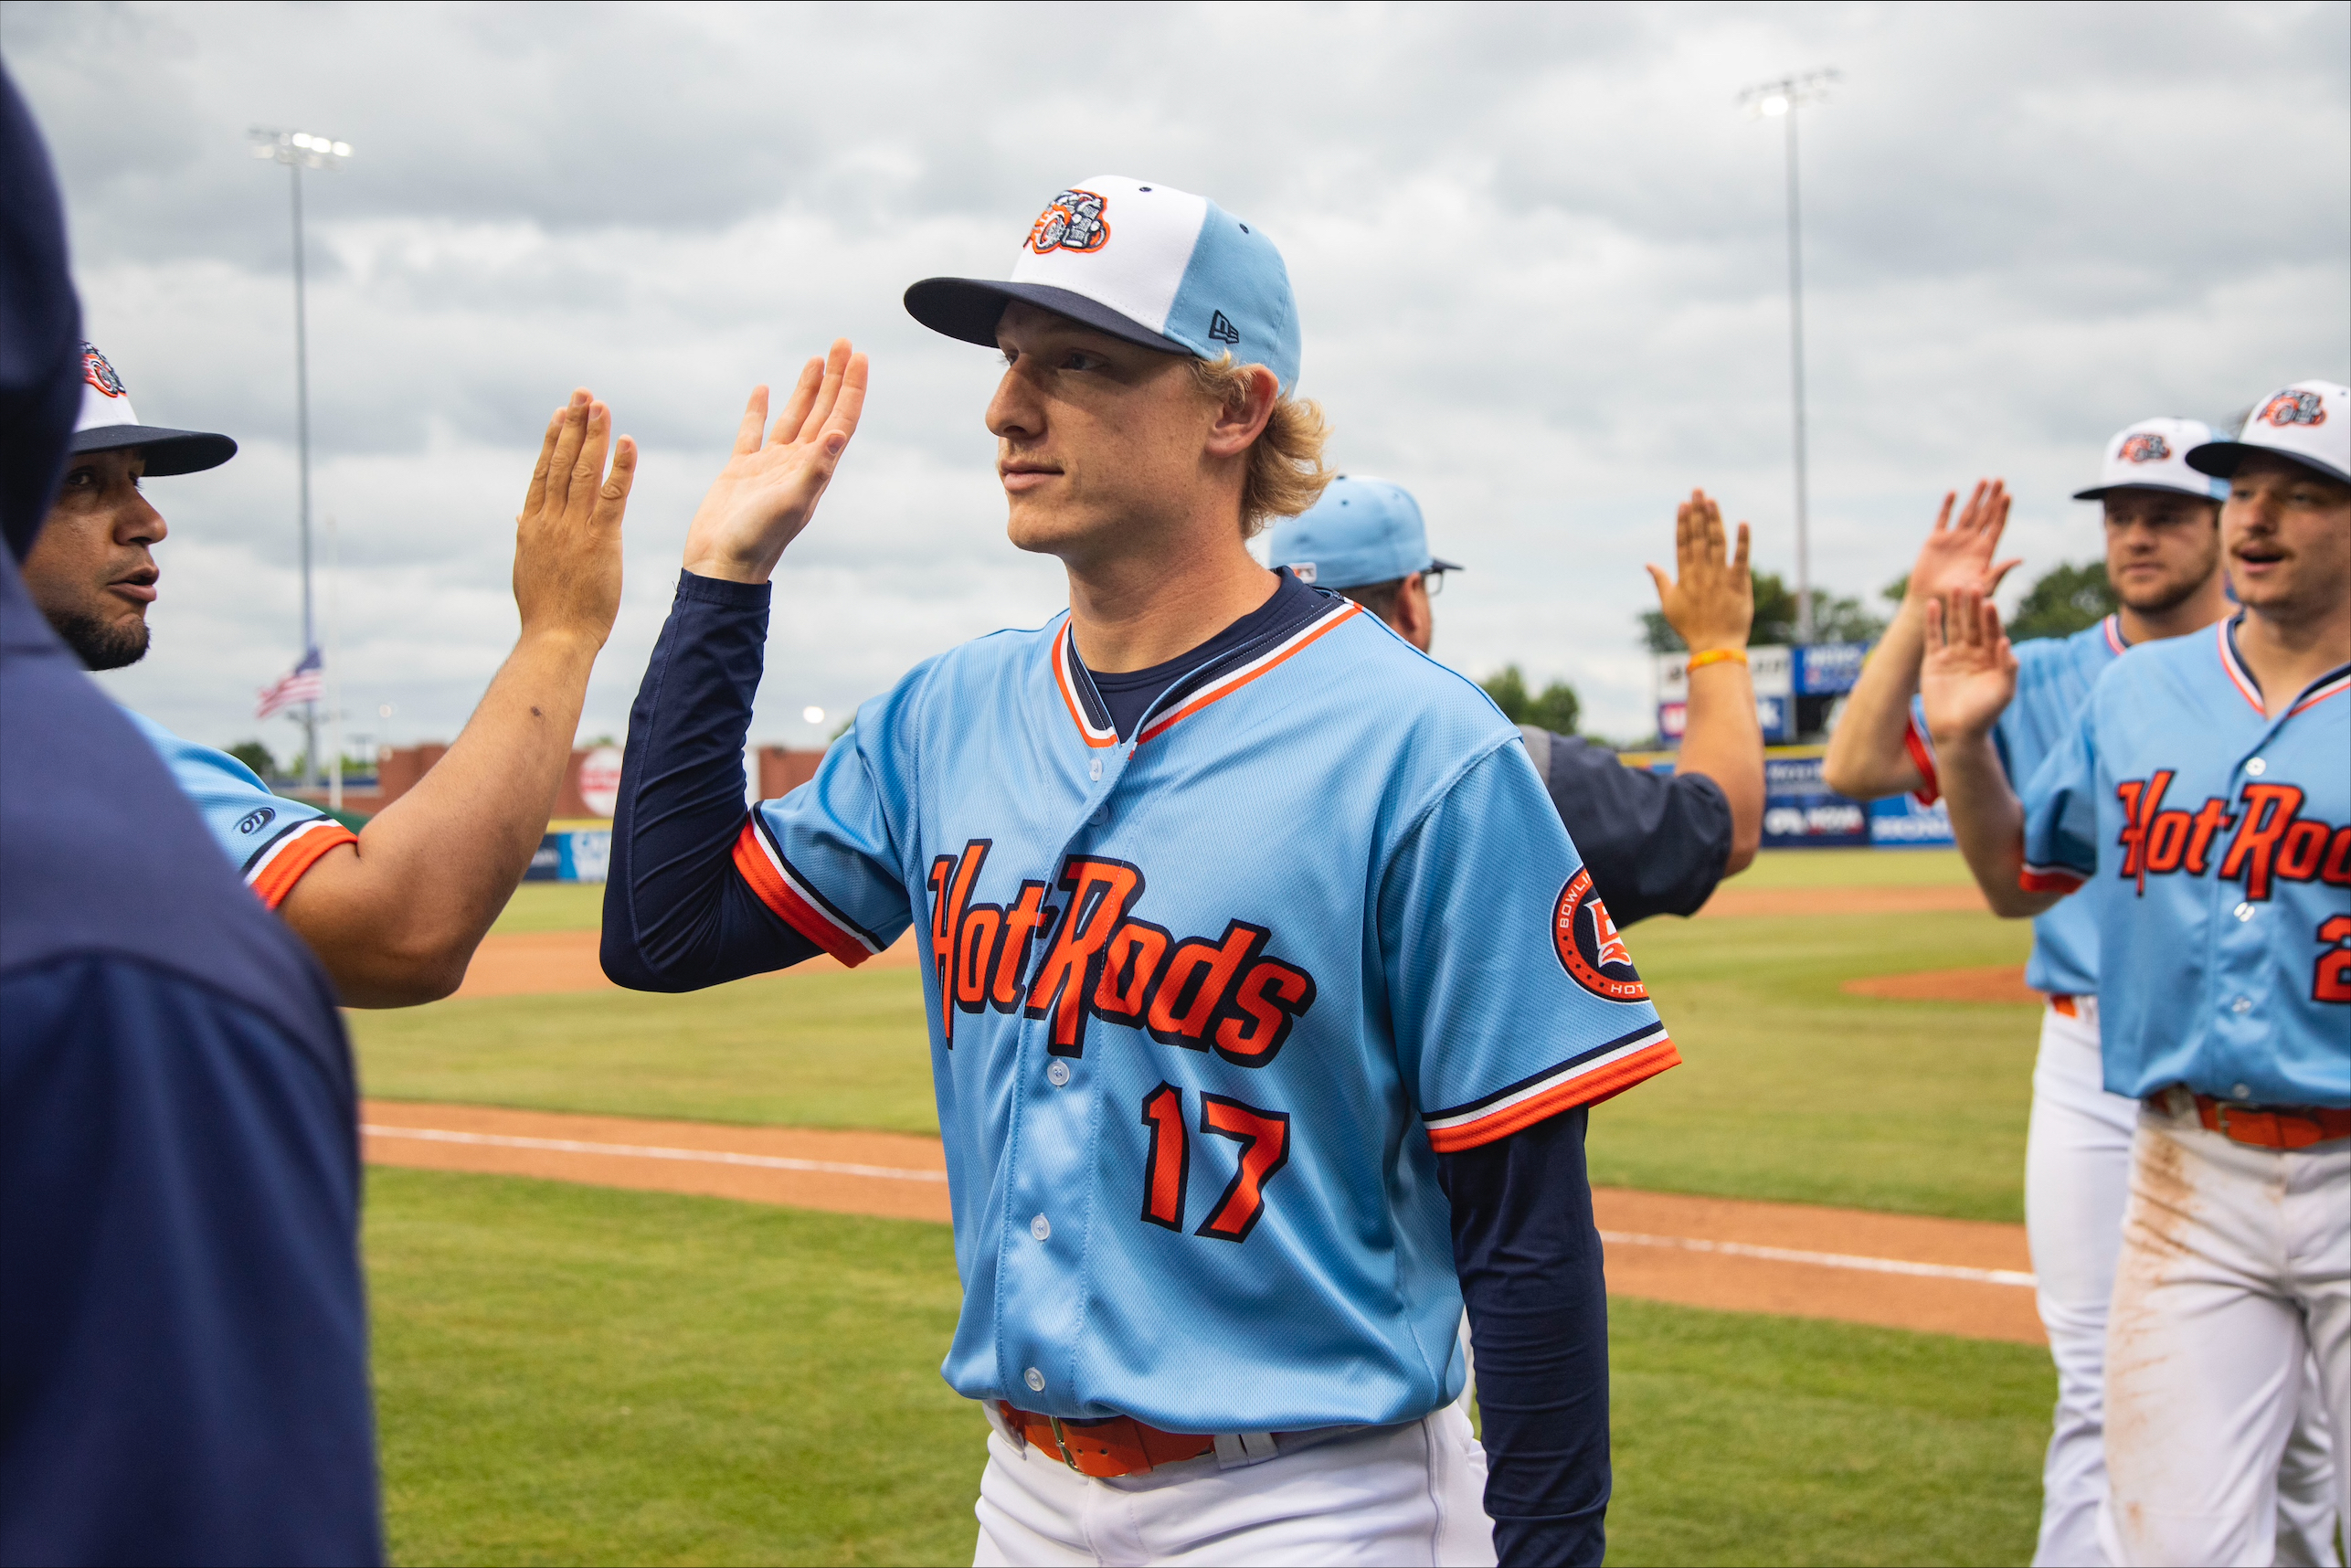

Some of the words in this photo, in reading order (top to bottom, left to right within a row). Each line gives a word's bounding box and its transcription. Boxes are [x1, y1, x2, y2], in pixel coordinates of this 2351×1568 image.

[2116, 769, 2238, 897] Hot
[927, 838, 1059, 1050] Hot
[1023, 854, 1317, 1068] Rods
[1610, 983, 1644, 995] HOT
[1141, 1079, 1290, 1243] 17
